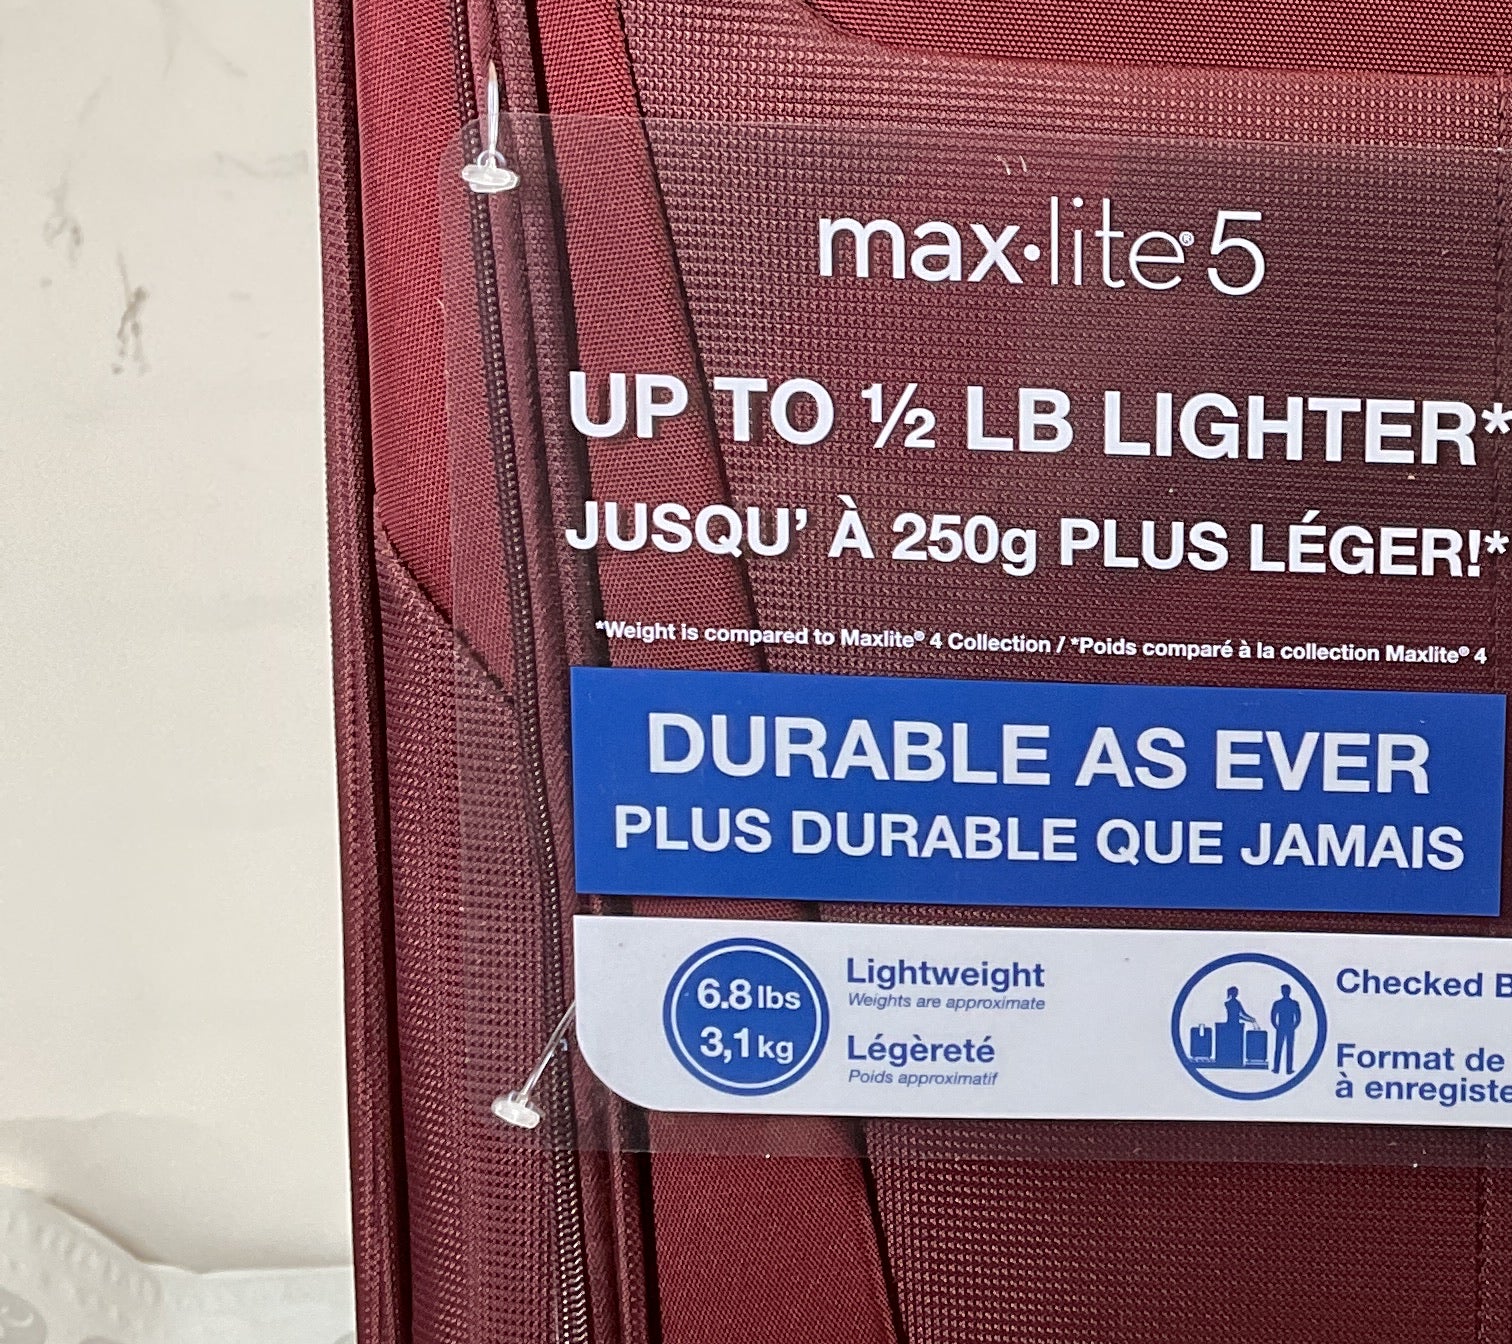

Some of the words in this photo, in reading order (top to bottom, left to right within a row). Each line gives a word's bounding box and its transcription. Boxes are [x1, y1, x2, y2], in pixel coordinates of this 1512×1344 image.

[1206, 209, 1267, 297] 5
[568, 369, 689, 442] UP
[714, 375, 834, 448] TO
[965, 386, 1074, 455] LB
[829, 494, 873, 561] À
[892, 513, 1037, 579] 250g
[1060, 518, 1230, 572] PLUS
[681, 623, 698, 641] is
[704, 625, 808, 648] compared
[813, 628, 835, 646] to
[930, 632, 943, 649] 4
[948, 632, 1051, 654] Collection
[1056, 636, 1066, 653] /
[1142, 639, 1234, 660] comparé
[1239, 640, 1252, 659] à
[1257, 641, 1275, 659] la
[1280, 643, 1380, 662] collection
[1473, 647, 1487, 665] 4
[647, 710, 1052, 787] DURABLE
[1075, 724, 1189, 791] AS
[1214, 728, 1431, 796] EVER
[613, 803, 772, 855] PLUS
[791, 810, 1078, 864] DURABLE
[1095, 818, 1223, 868] QUE
[1240, 822, 1466, 872] JAMAIS
[846, 957, 1045, 993] Lightweight
[1336, 967, 1484, 997] Checked
[696, 977, 752, 1011] 6.8
[758, 985, 801, 1012] lbs
[848, 992, 911, 1010] Weights
[915, 995, 941, 1009] are
[945, 995, 1046, 1012] approximate
[700, 1026, 749, 1064] 3,1
[758, 1035, 794, 1065] kg
[847, 1034, 995, 1067] Légèreté
[1337, 1043, 1454, 1070] Format
[1465, 1047, 1505, 1072] de
[848, 1069, 893, 1085] Poids
[898, 1071, 999, 1088] approximatif
[1335, 1072, 1354, 1099] à
